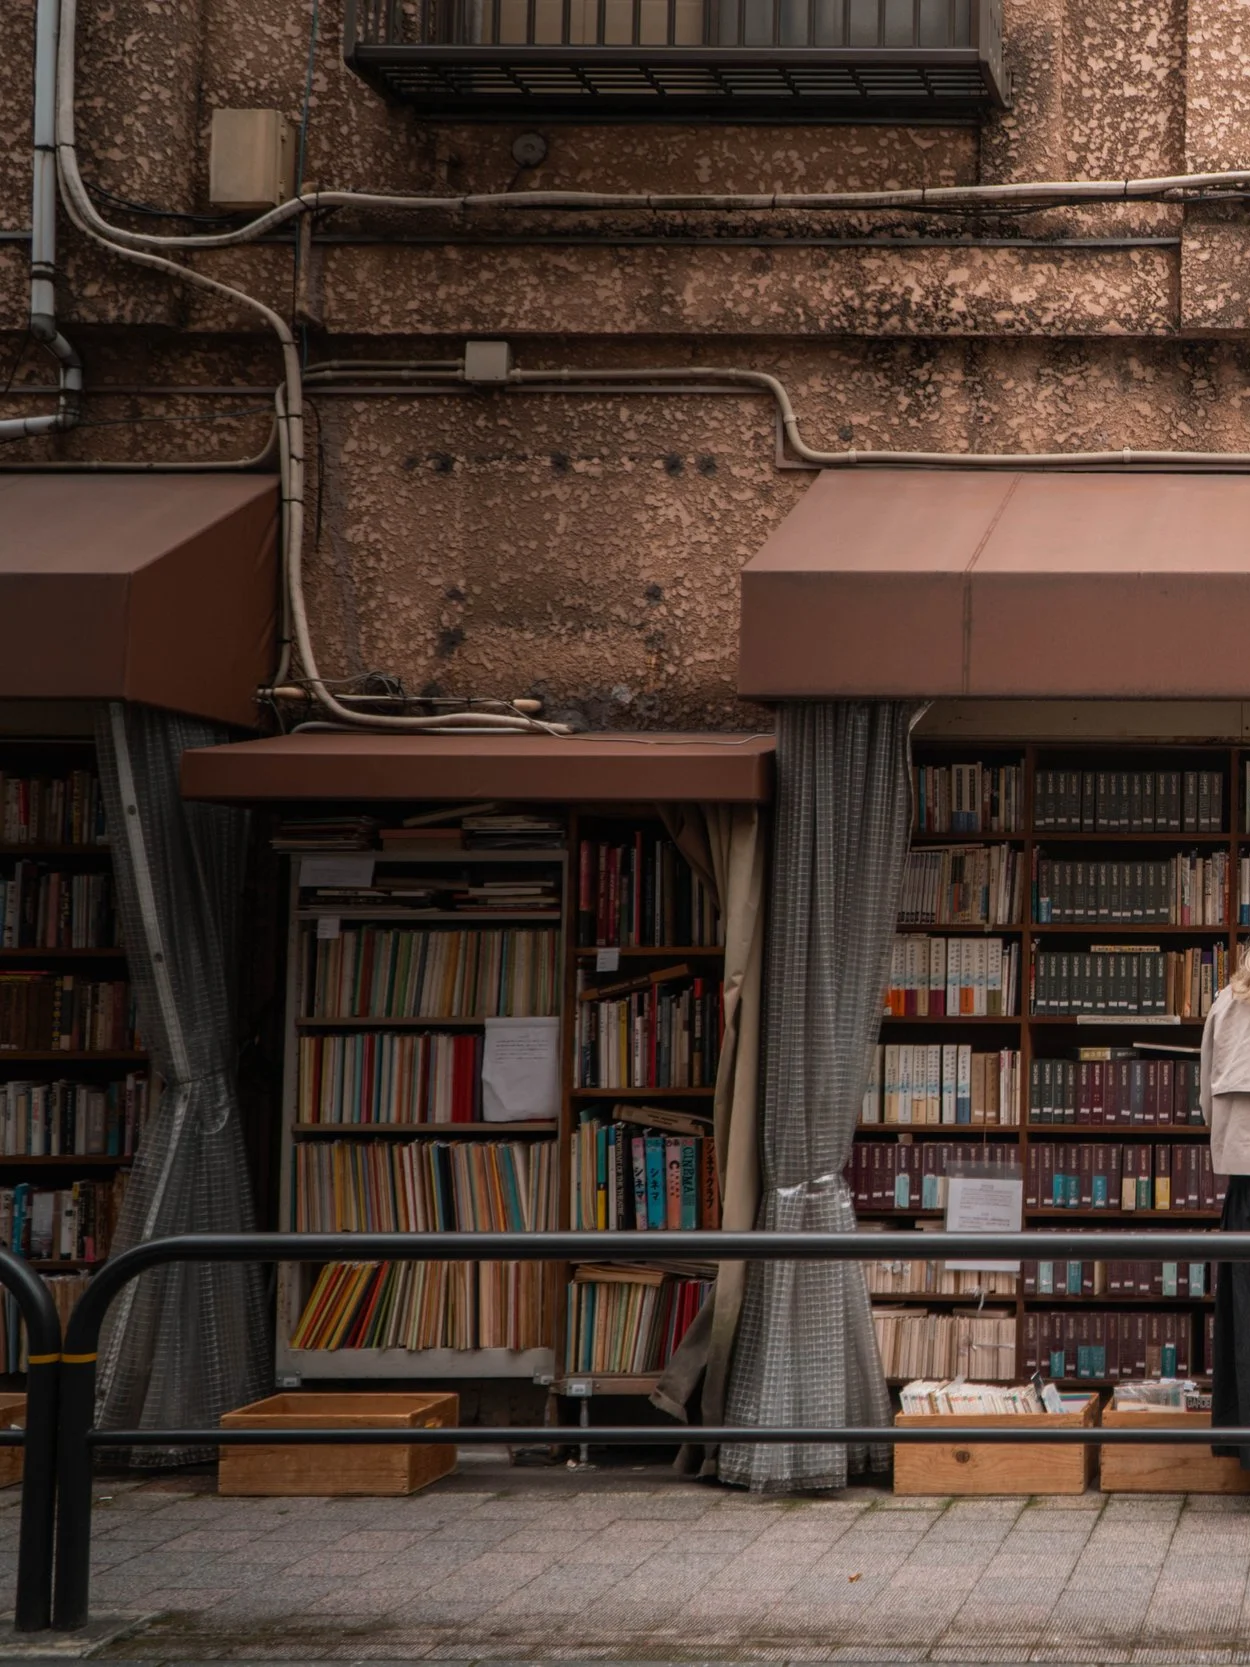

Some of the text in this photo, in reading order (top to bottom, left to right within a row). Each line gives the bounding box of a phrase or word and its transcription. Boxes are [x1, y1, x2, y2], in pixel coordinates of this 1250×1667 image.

[649, 1167, 660, 1202] シネマ
[682, 1146, 696, 1193] CINEMA
